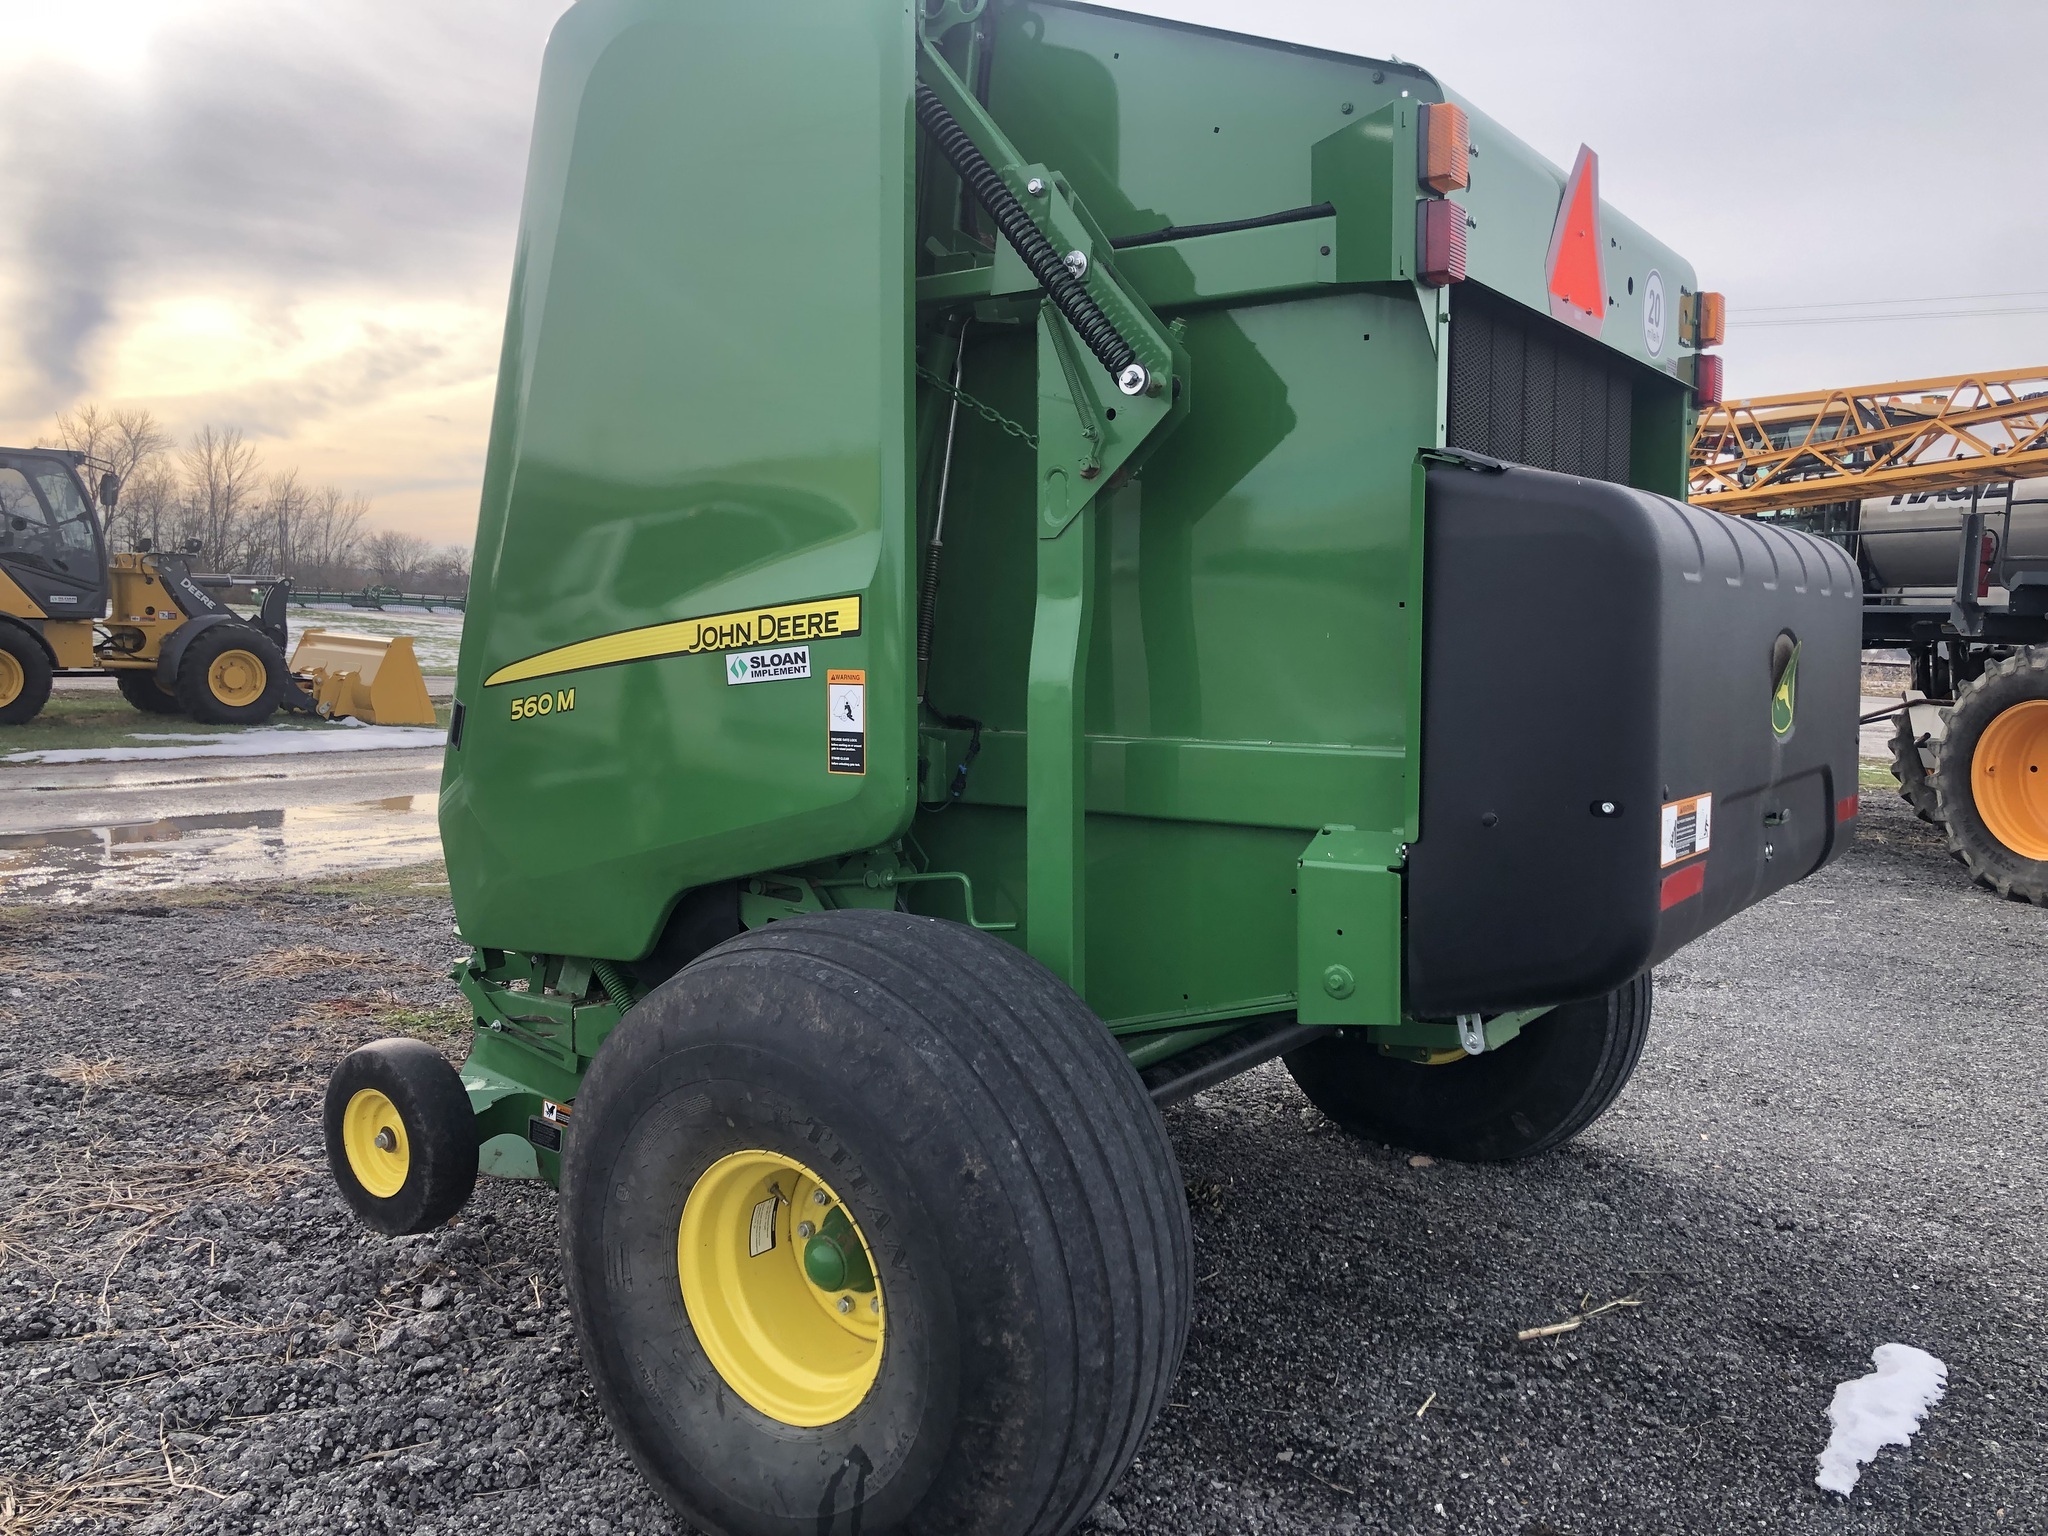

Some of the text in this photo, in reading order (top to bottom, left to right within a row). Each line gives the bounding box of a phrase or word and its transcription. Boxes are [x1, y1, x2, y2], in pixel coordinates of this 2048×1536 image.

[1648, 289, 1660, 328] 20
[180, 577, 217, 610] DEERE
[689, 611, 839, 650] JOHN DEERE
[750, 651, 807, 669] SLOAN
[751, 665, 807, 678] IMPLEMENT
[511, 687, 576, 721] 560 M
[806, 1117, 917, 1280] TITAN
